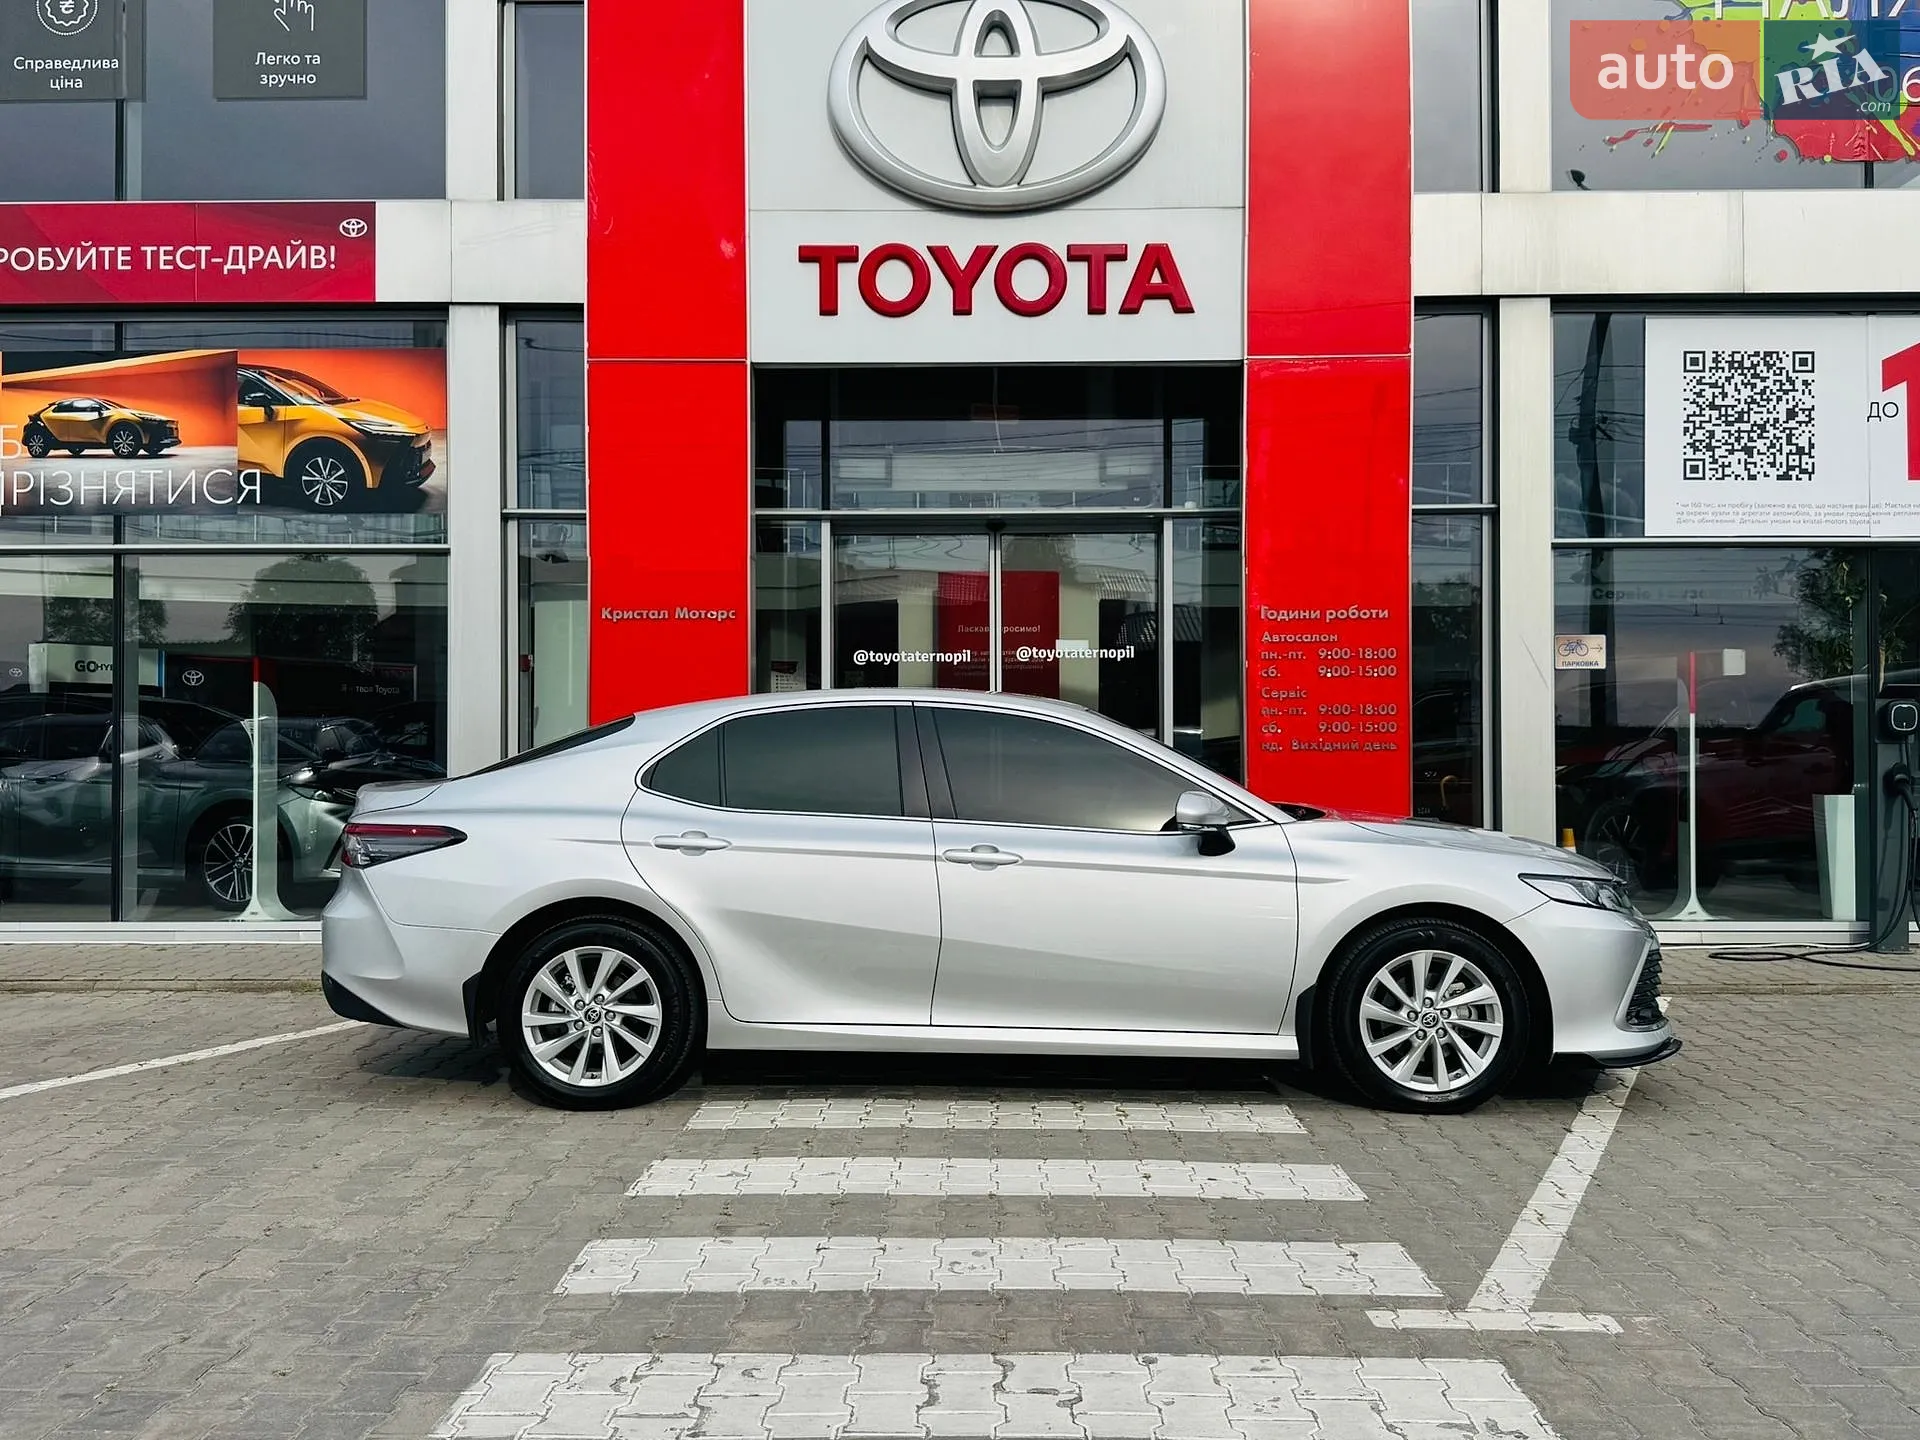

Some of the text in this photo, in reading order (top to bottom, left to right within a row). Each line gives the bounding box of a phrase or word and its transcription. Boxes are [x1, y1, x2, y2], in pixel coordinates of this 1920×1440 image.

[13, 55, 119, 72] Справедлива
[255, 52, 321, 65] Легко та
[49, 75, 83, 91] ціна
[260, 73, 317, 88] зручно
[140, 239, 336, 275] ТЕСТ-ДРАЙВ!
[798, 242, 1195, 318] TOYOTA
[0, 468, 261, 508] РІЗНЯТИСЯ
[601, 607, 736, 622] Кристал Моторс
[1260, 604, 1389, 622] Години роботи
[1261, 631, 1338, 642] Автосалон
[853, 649, 971, 665] @toyotaternopil
[1016, 645, 1135, 662] @toyotaternopil
[1261, 651, 1307, 660] пн.-пт.
[1261, 665, 1281, 677] сб.
[1261, 685, 1308, 700] Сервіс
[1261, 706, 1307, 716] пн.-пт.
[1261, 721, 1282, 733] сб.
[1261, 738, 1397, 751] нд. Вихідний день
